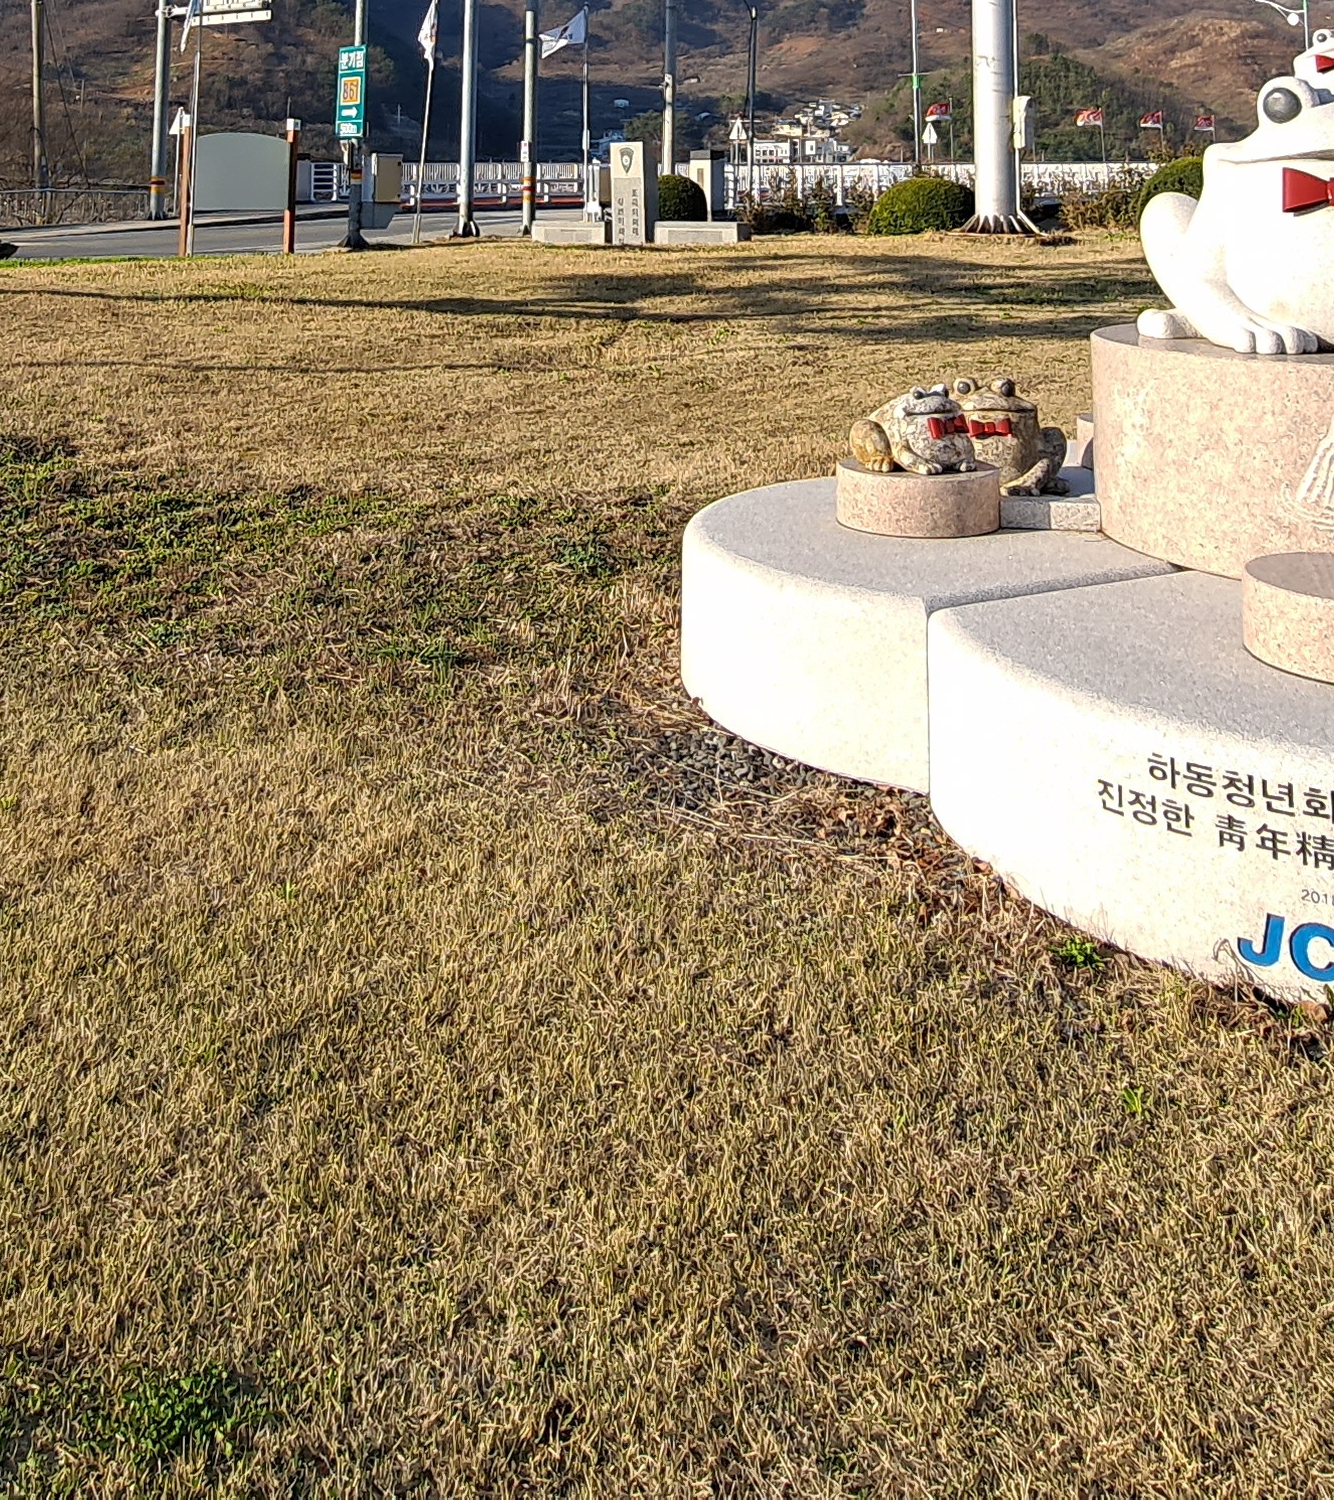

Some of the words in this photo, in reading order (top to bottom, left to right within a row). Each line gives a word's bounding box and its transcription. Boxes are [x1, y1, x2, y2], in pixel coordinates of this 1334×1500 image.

[340, 51, 364, 70] 분기점
[343, 82, 359, 100] 861
[1096, 778, 1195, 838] 진정한
